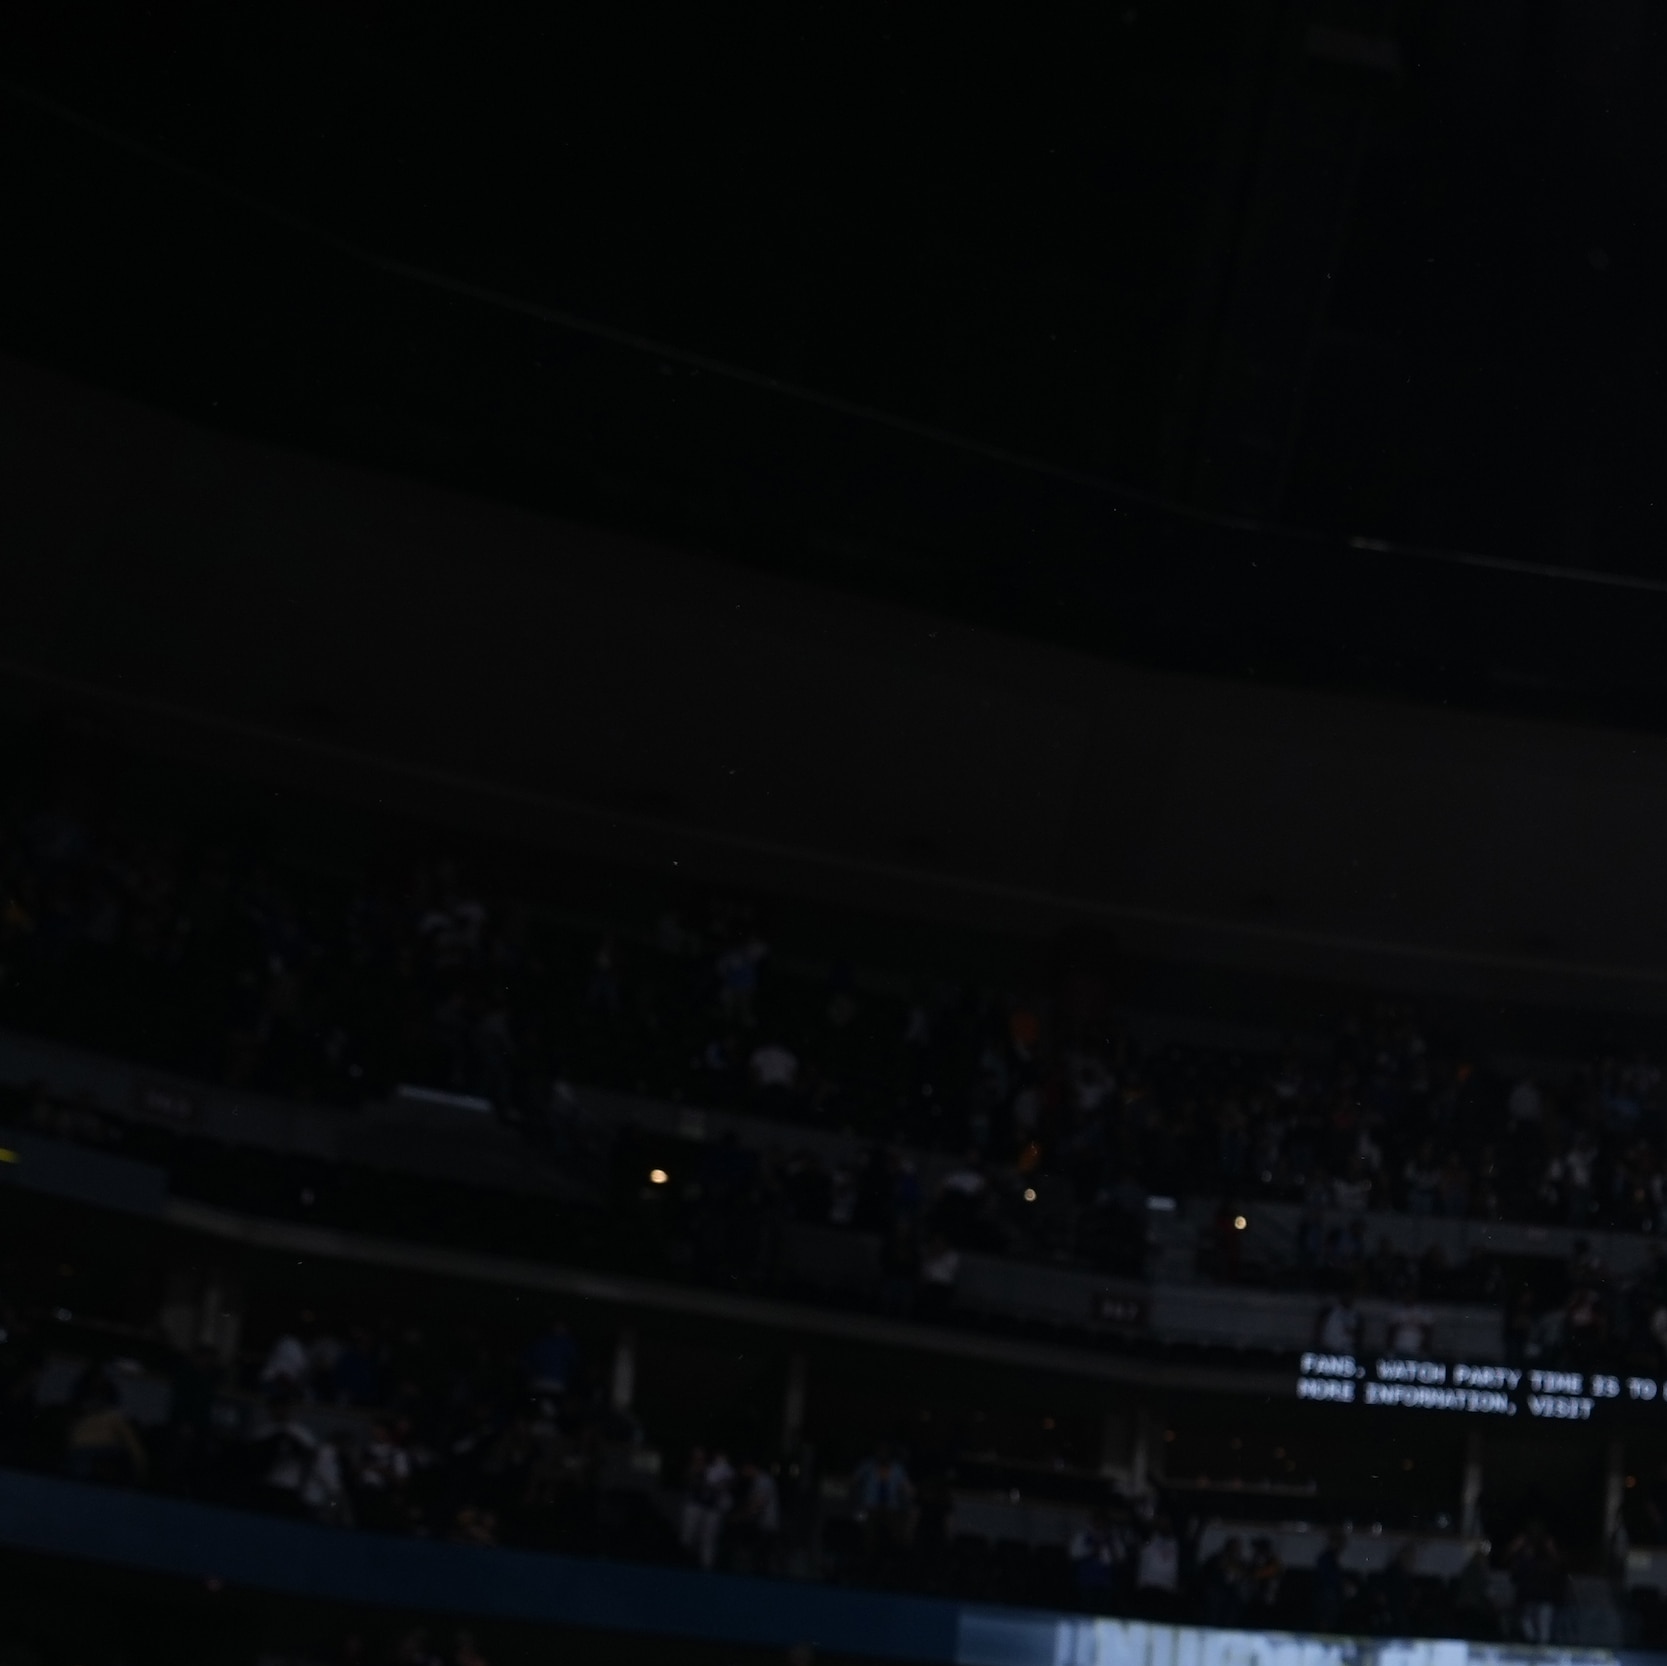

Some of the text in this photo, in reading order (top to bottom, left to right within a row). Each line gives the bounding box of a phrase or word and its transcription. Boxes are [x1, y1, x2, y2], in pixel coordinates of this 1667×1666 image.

[1297, 1376, 1356, 1403] MORE
[1528, 1394, 1595, 1420] VISIT
[1376, 1358, 1447, 1385] WATCH
[1453, 1363, 1522, 1390] PARTY
[1528, 1369, 1583, 1395] TIME
[1626, 1377, 1657, 1400] TO
